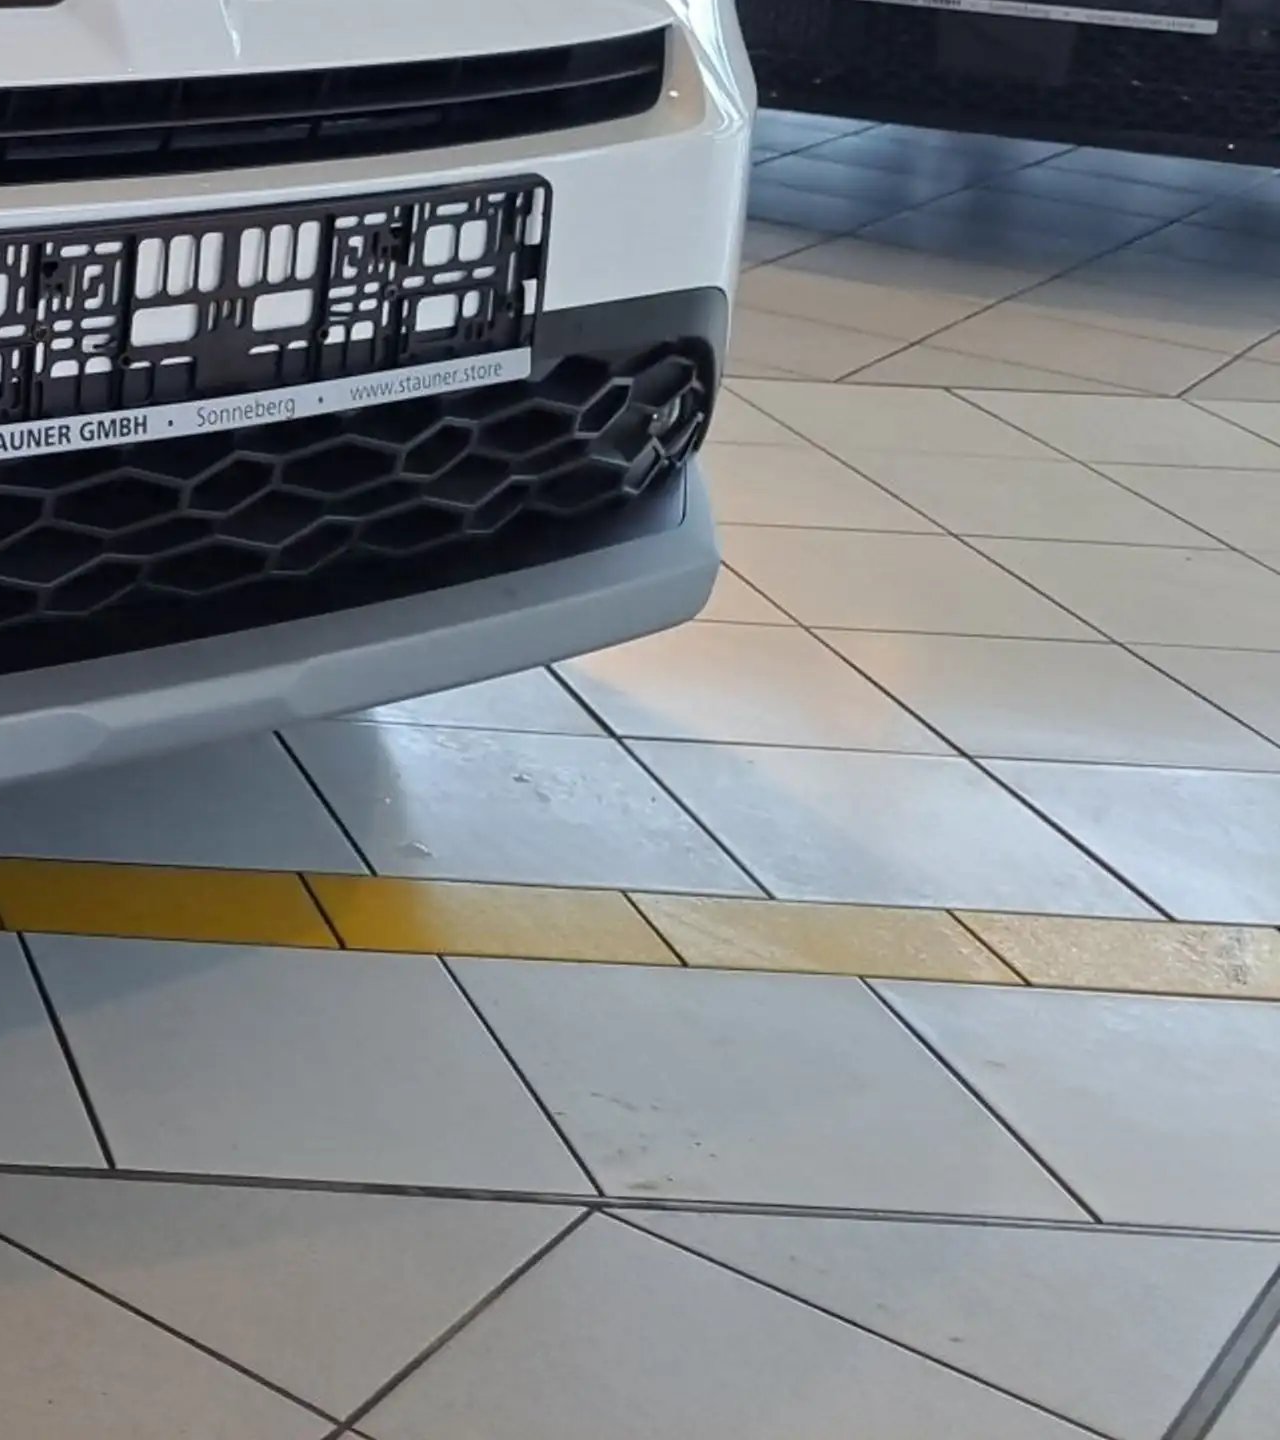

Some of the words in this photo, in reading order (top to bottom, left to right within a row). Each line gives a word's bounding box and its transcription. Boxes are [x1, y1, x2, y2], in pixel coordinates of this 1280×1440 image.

[79, 414, 148, 444] GMBH
[196, 396, 296, 428] Sonneberg
[349, 362, 503, 402] www.stauner.store
